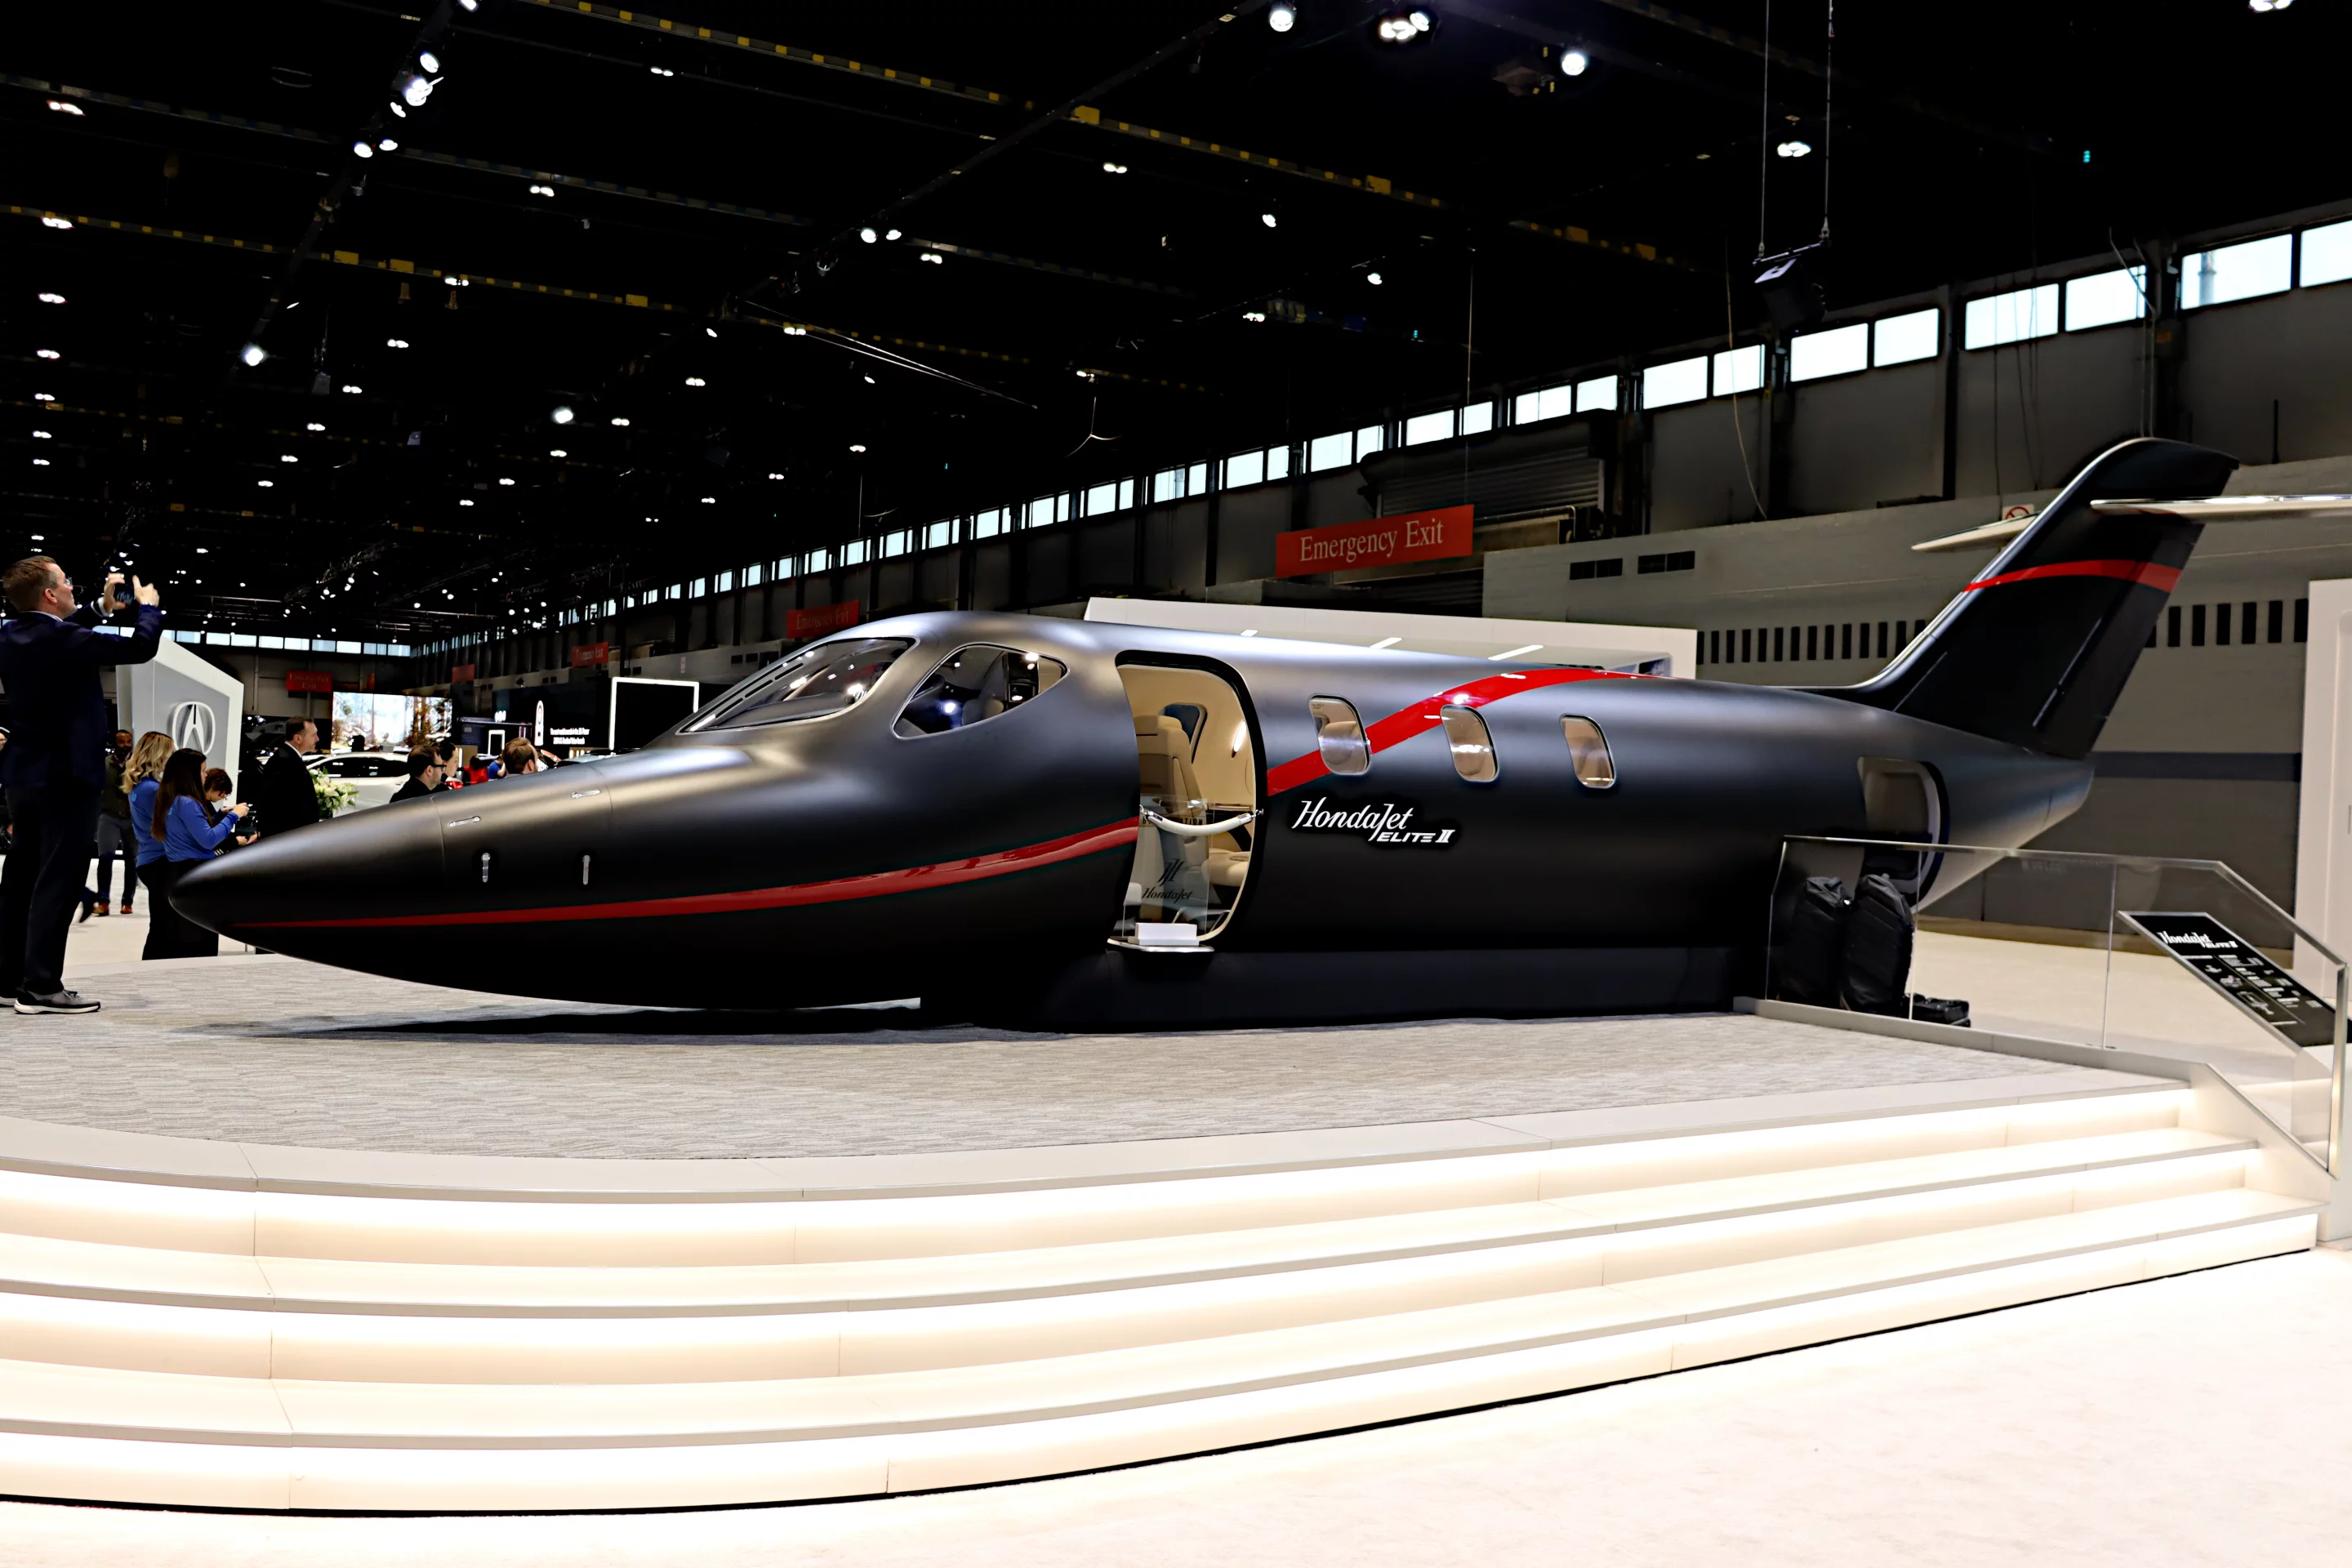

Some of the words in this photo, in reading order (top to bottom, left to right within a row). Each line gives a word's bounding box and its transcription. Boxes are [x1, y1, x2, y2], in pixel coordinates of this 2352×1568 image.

[1300, 530, 1398, 563] Emergency
[1405, 518, 1444, 548] Exit
[1291, 797, 1414, 841] HondaJet
[1376, 832, 1436, 843] ELITE
